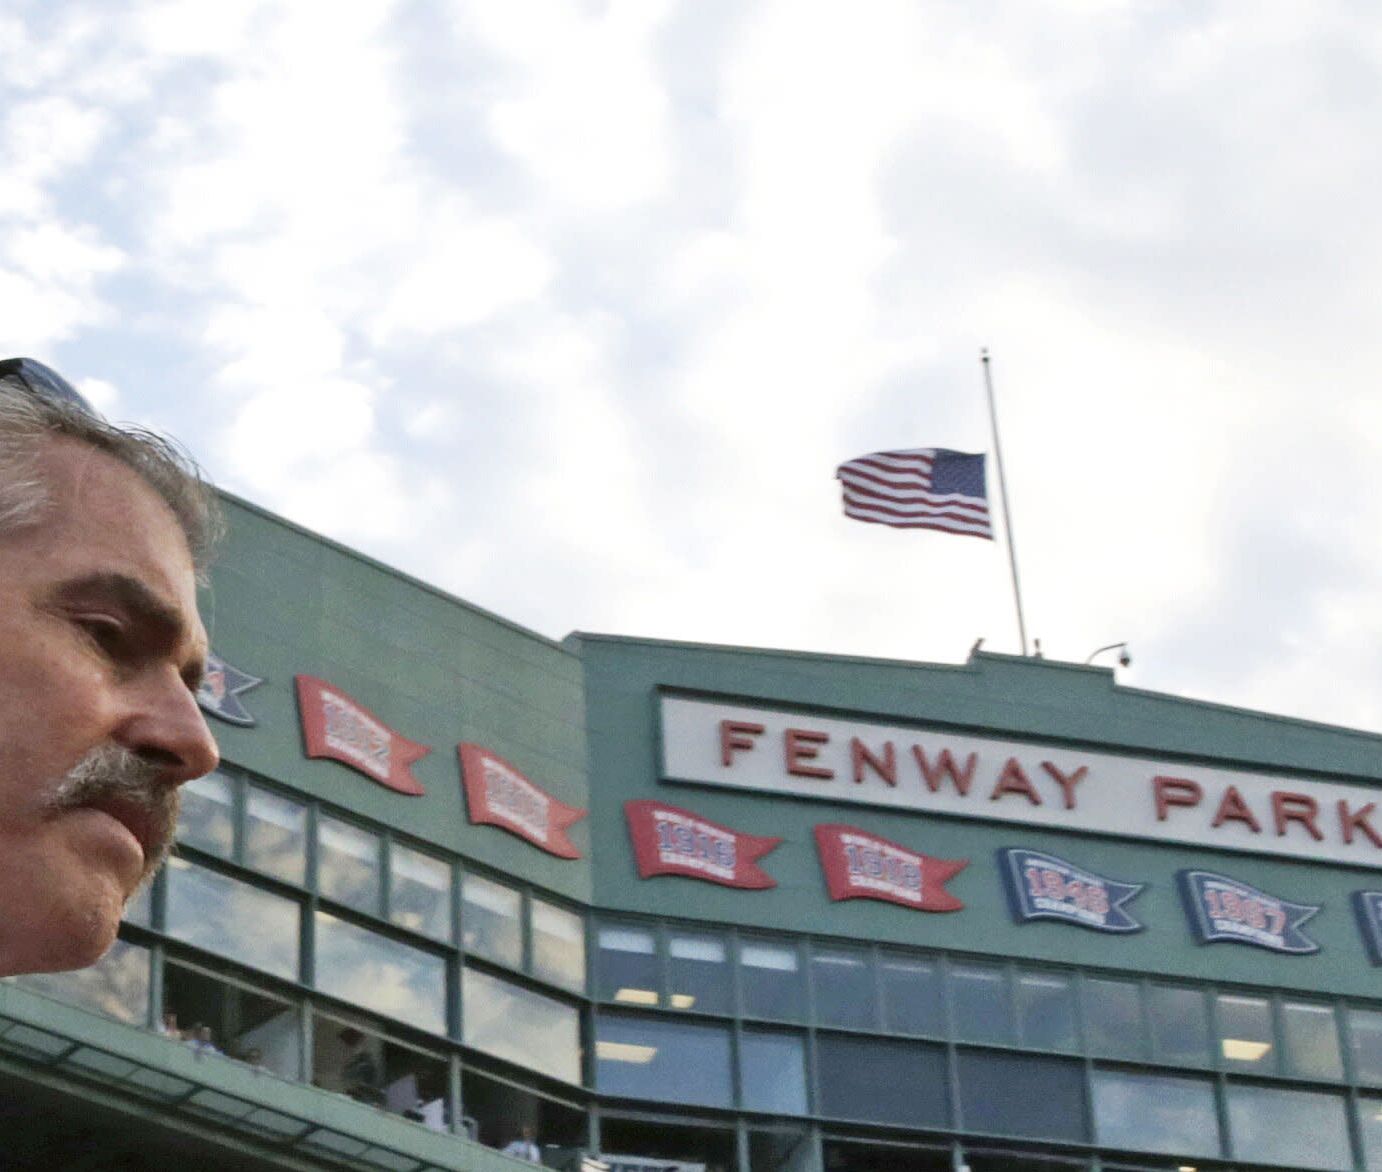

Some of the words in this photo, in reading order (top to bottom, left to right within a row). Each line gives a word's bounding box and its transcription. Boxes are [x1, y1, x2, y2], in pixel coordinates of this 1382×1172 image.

[721, 719, 1088, 810] FENWAY
[656, 821, 736, 869] 1916
[1203, 889, 1287, 936] 1967
